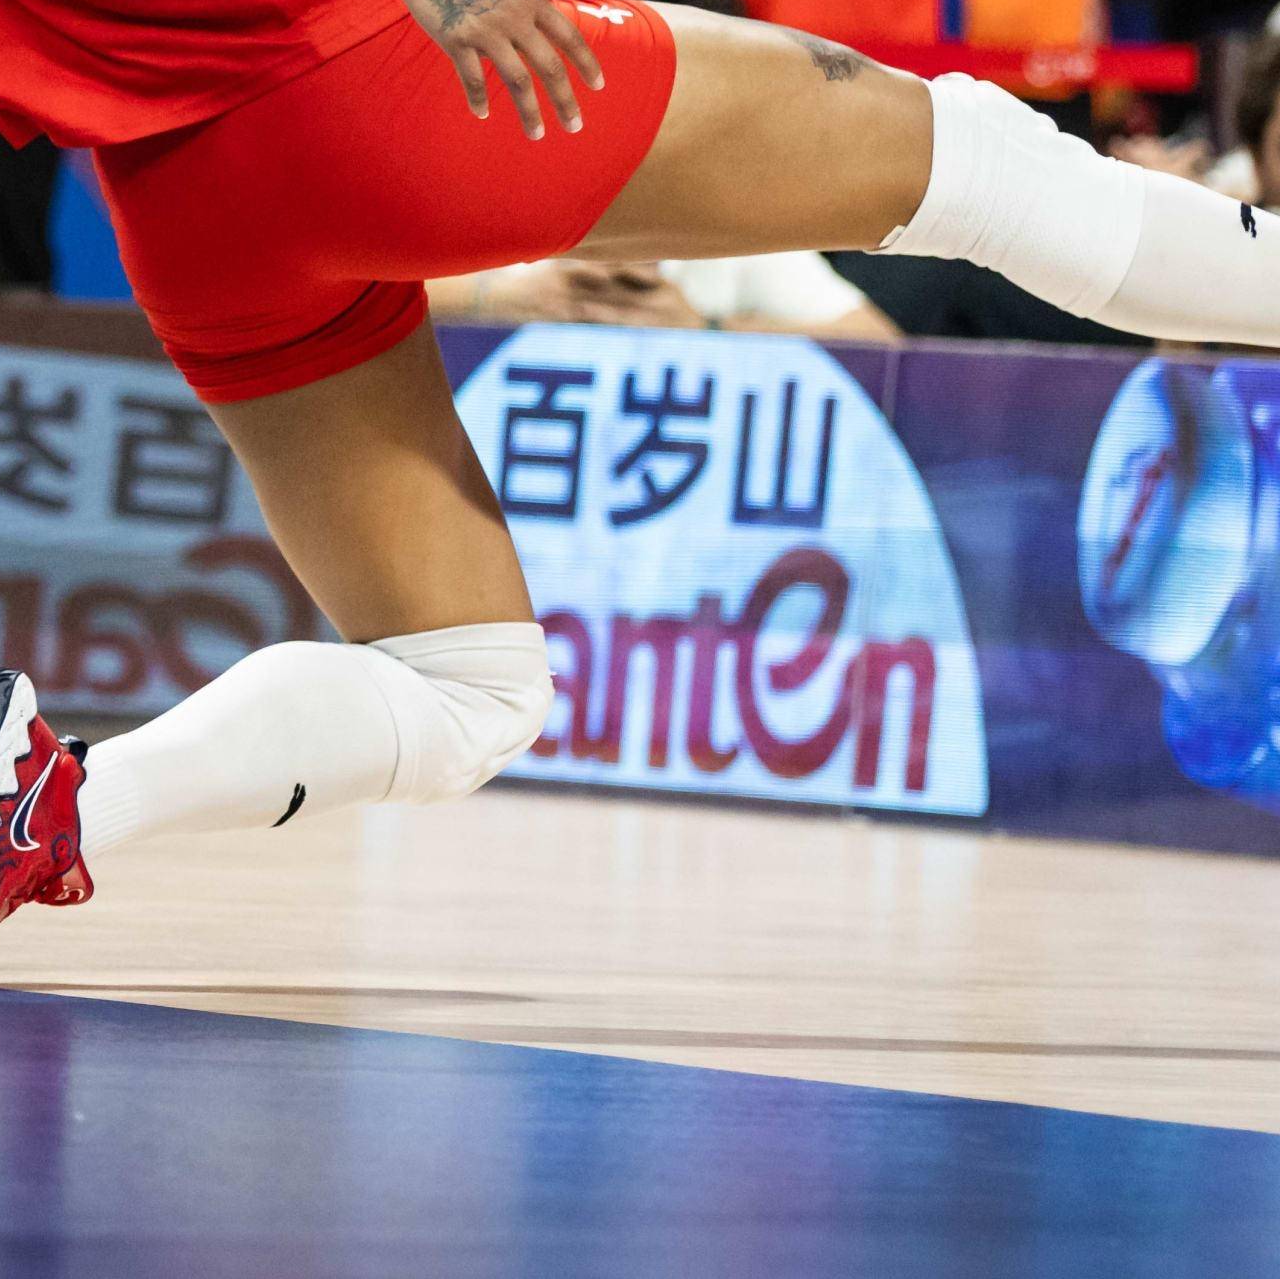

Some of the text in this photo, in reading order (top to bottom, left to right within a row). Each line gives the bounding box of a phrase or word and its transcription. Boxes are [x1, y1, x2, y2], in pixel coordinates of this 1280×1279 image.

[499, 364, 838, 529] 百岁山
[526, 547, 936, 794] anten
